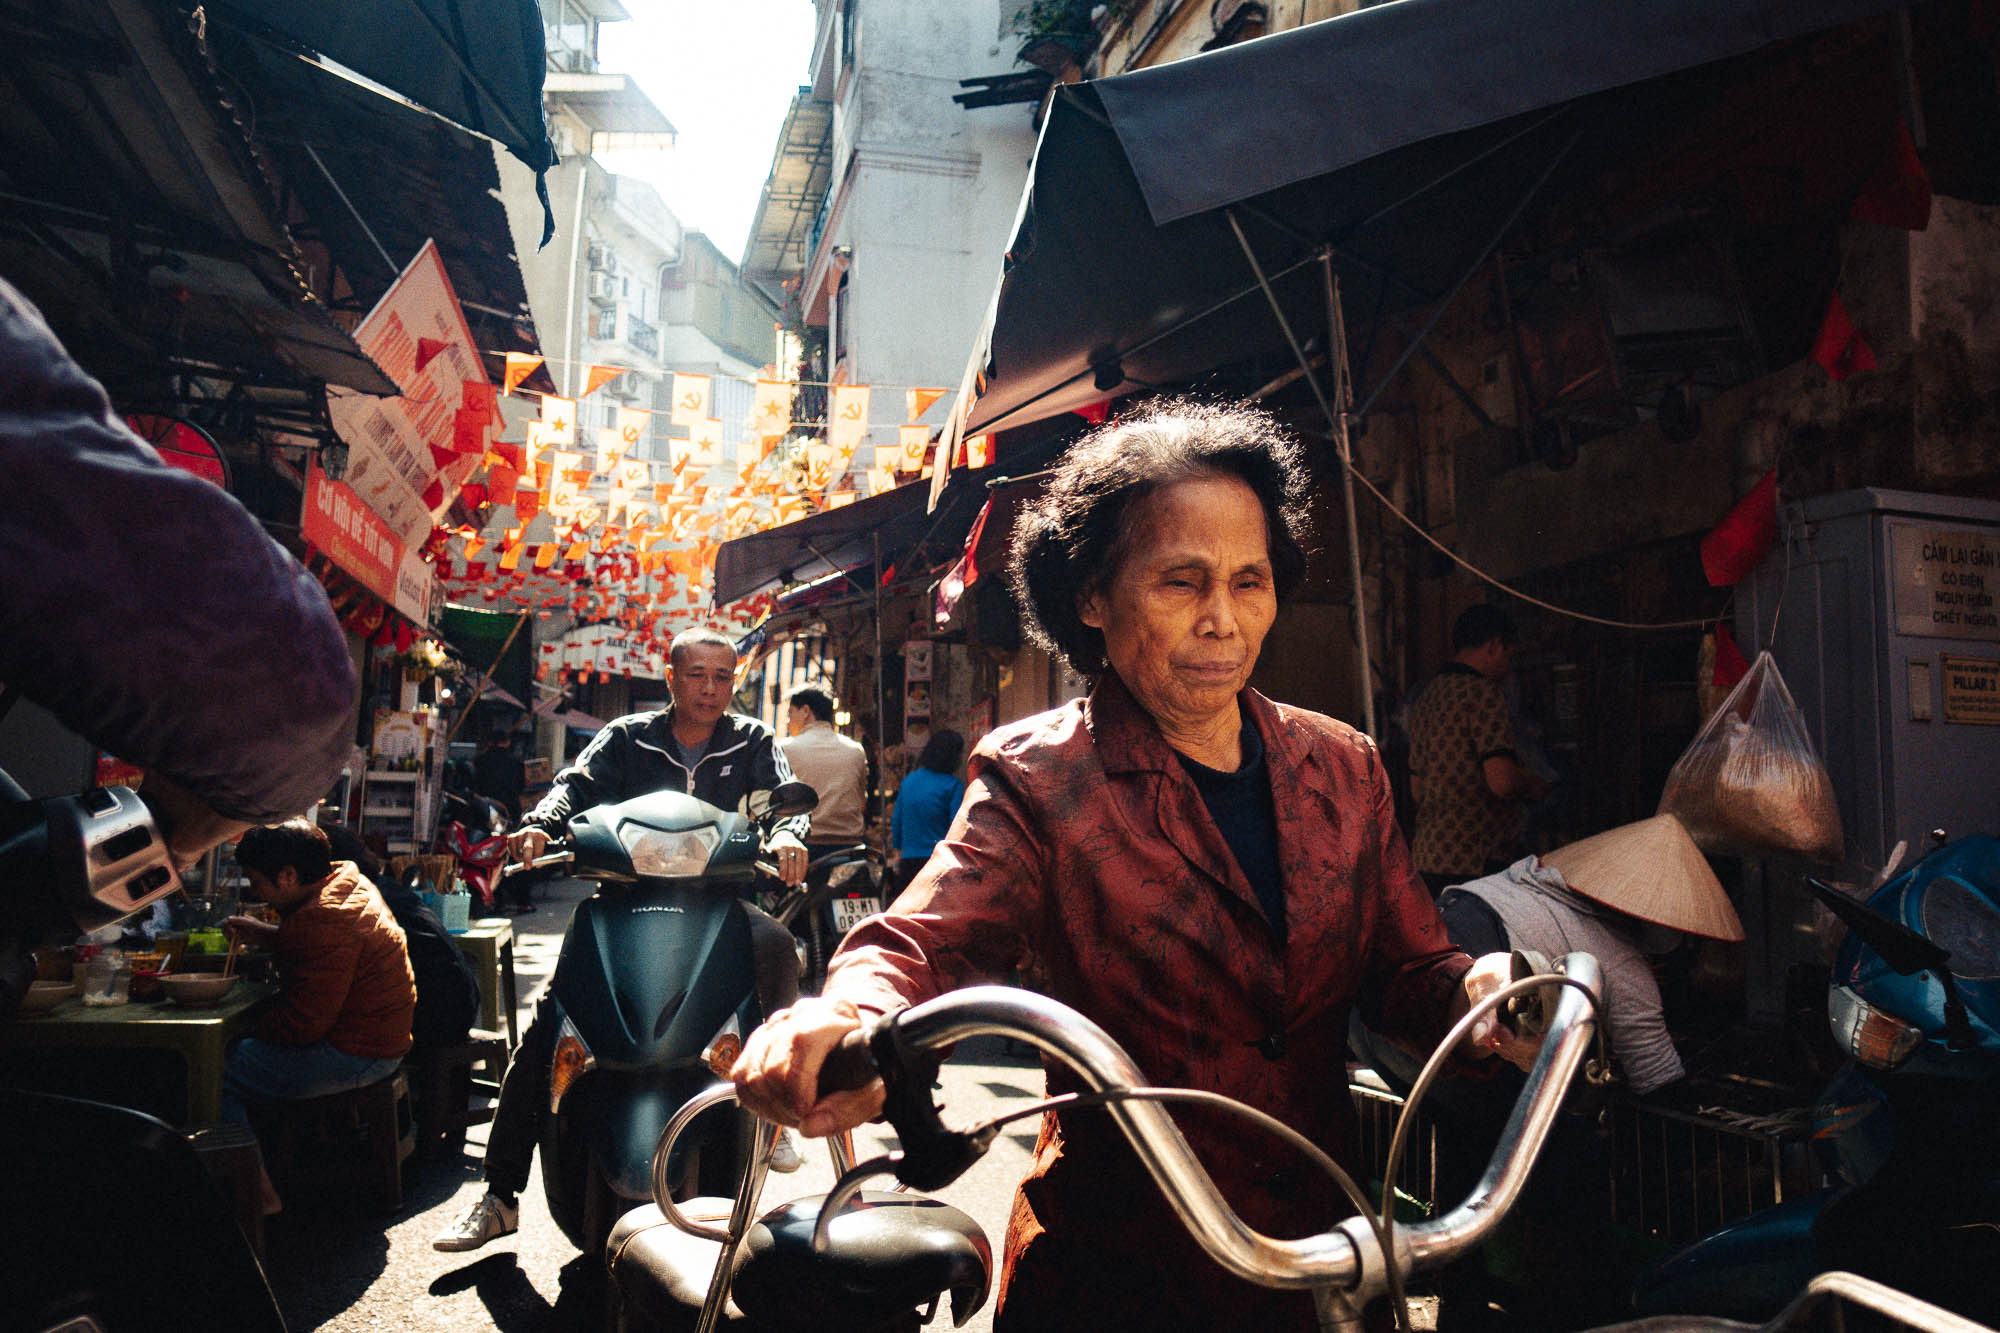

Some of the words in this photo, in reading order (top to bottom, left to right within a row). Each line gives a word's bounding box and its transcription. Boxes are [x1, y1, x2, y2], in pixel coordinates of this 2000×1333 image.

[1953, 675, 1987, 692] PILLAR
[1990, 678, 1997, 692] 3
[631, 904, 685, 914] HONDA
